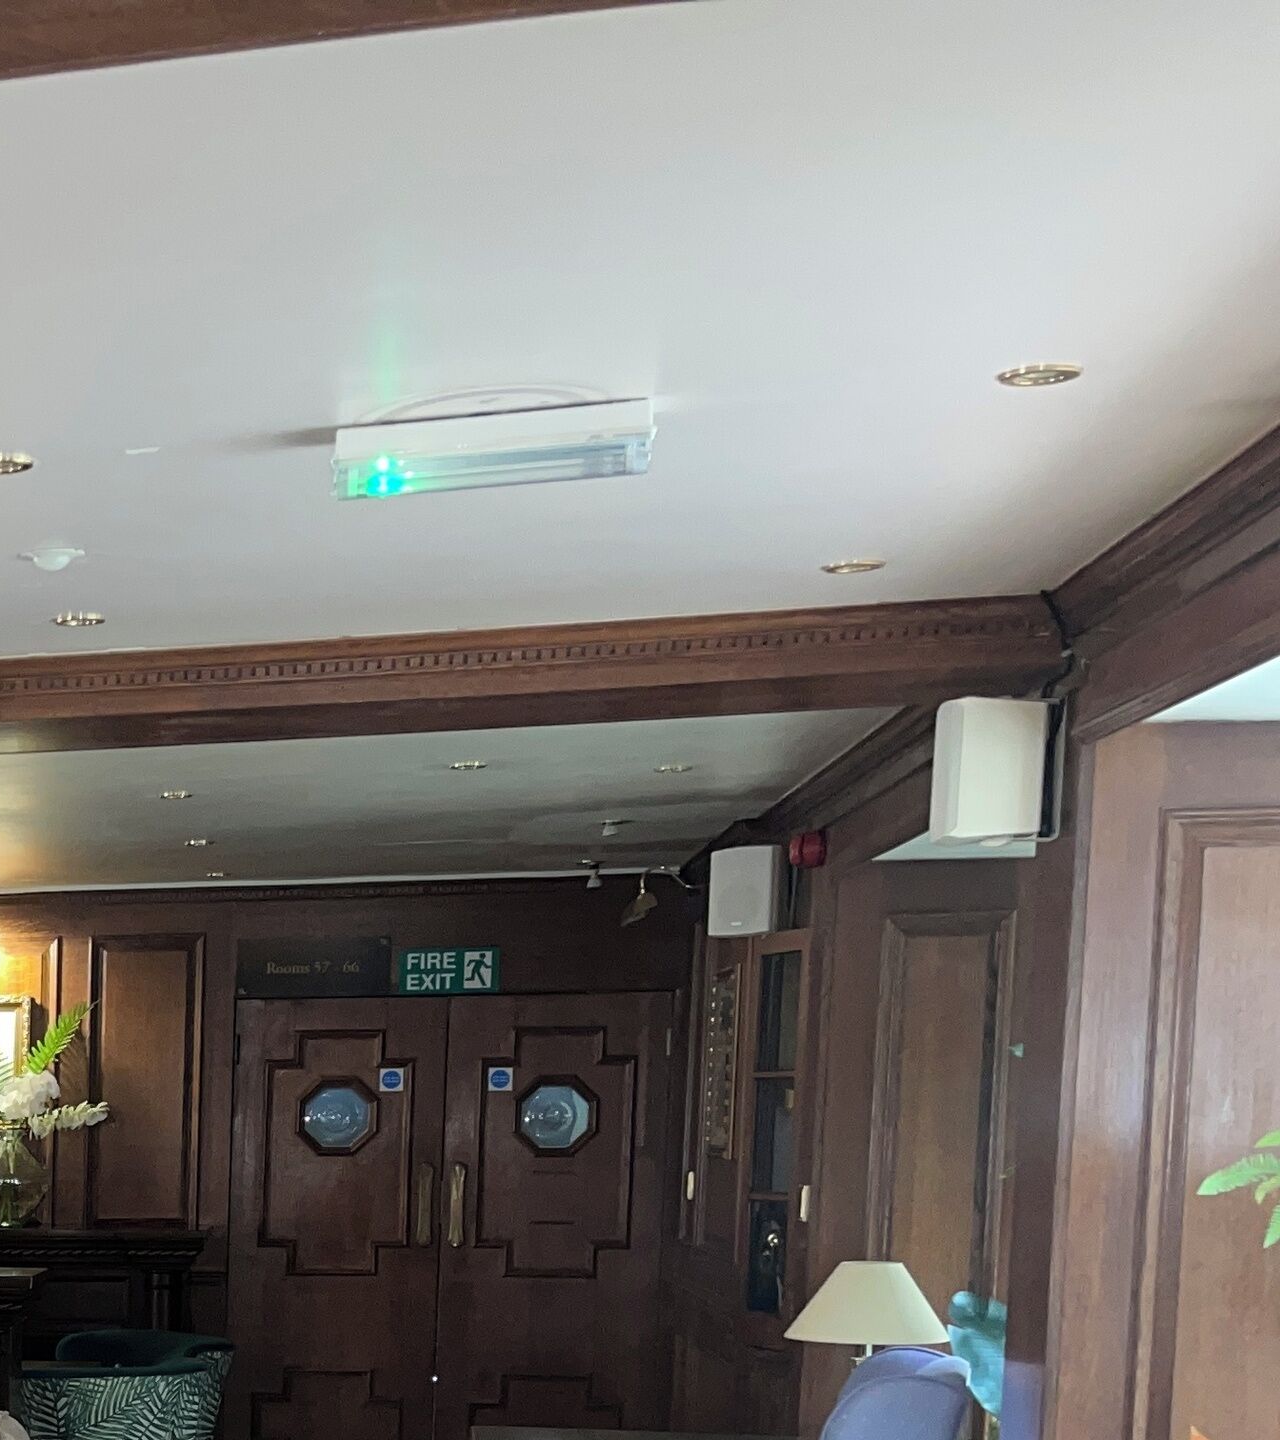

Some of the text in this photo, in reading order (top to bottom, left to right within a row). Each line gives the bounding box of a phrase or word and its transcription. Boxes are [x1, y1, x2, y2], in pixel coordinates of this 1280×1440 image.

[267, 961, 311, 974] Rooms
[343, 961, 359, 973] 66
[407, 951, 456, 970] FIRE
[406, 973, 455, 991] EXIT
